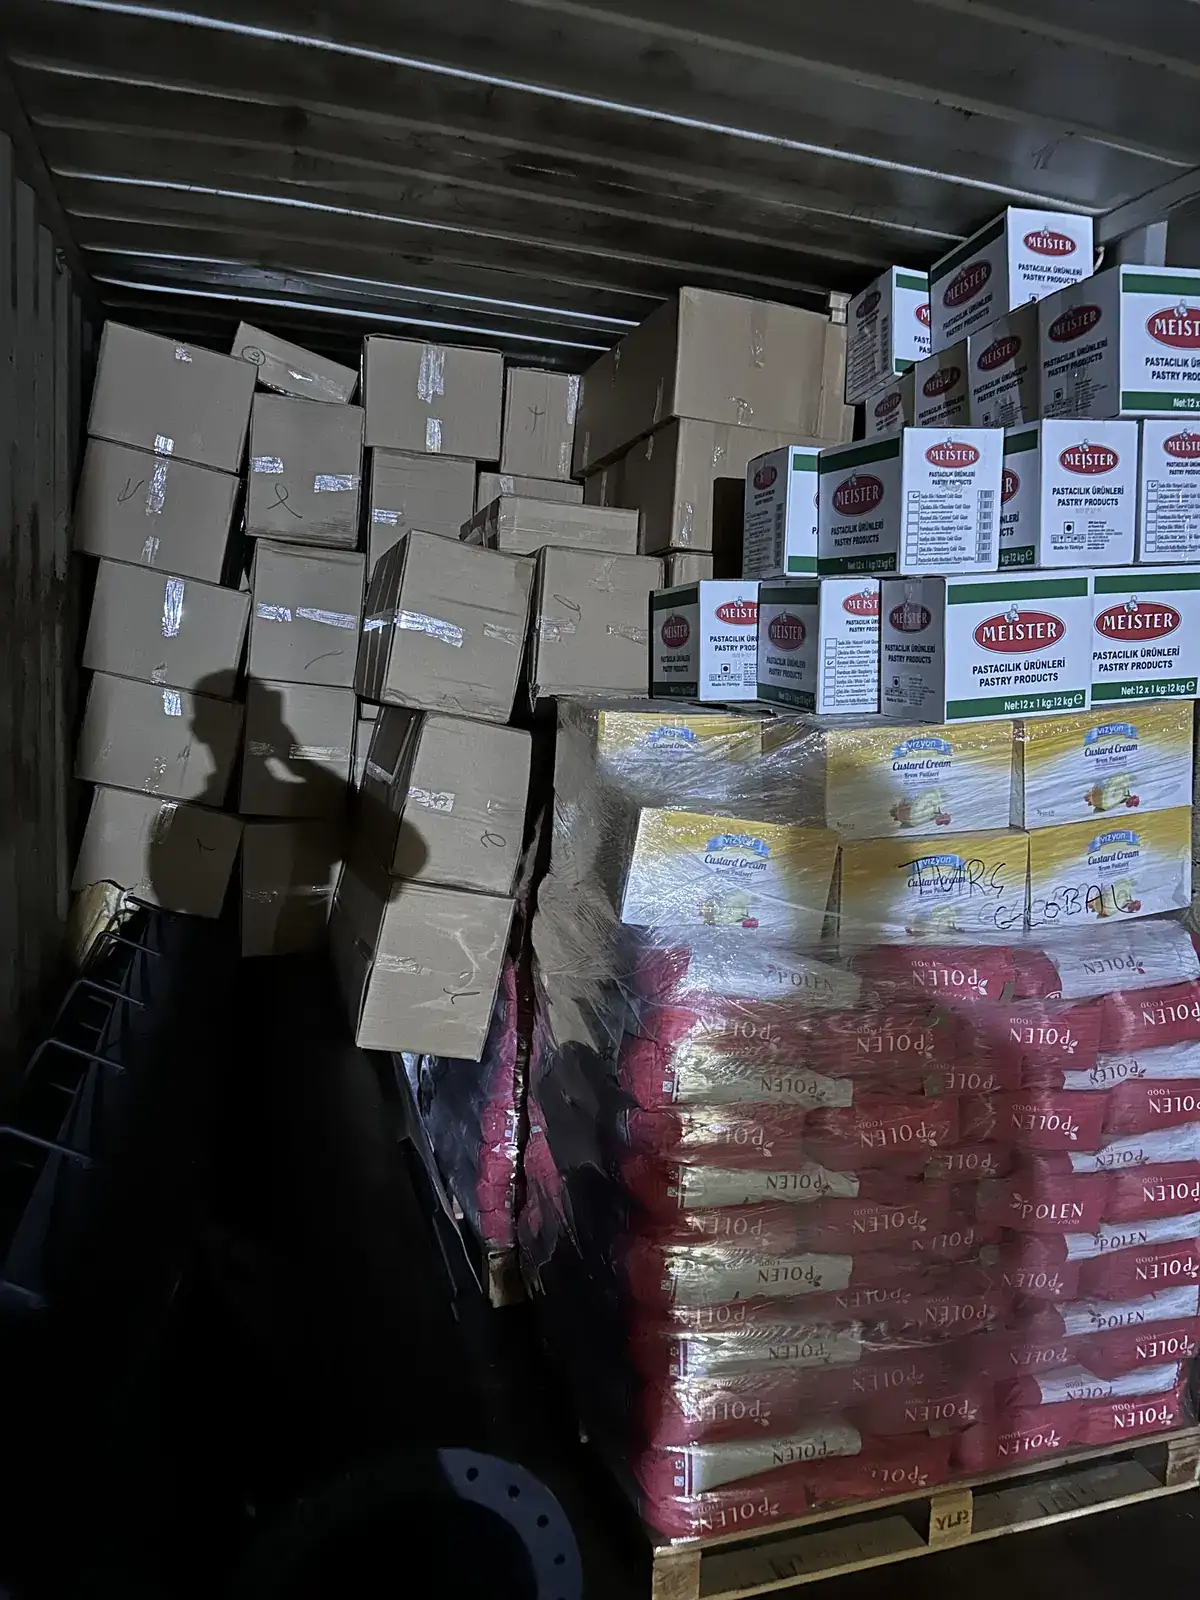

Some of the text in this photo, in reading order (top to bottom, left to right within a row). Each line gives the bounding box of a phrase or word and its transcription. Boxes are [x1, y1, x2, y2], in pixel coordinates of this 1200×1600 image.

[1028, 236, 1072, 251] MEISTER
[1018, 263, 1052, 273] PASTACILIK
[947, 266, 988, 299] MEISTER
[1023, 273, 1046, 282] PASTRY
[1053, 310, 1097, 336] MEISTER
[982, 341, 1018, 365] MEISTE
[1145, 357, 1189, 368] PASTACILIK
[1152, 371, 1180, 381] PASTRY
[930, 450, 975, 460] MEISTER
[1065, 454, 1114, 466] MEISTER
[836, 485, 879, 506] MEISTER
[1052, 486, 1124, 496] PASTACILIK ÜRÜNLERİ
[1058, 498, 1119, 506] PASTRY PRODUCTS
[835, 534, 879, 547] PASTRY PRODUCTS
[893, 612, 927, 624] MEISTER
[1102, 613, 1173, 631] MEISTER
[664, 625, 687, 638] MEISTER
[771, 624, 803, 640] MEISTER
[982, 622, 1057, 643] MEISTER
[1092, 645, 1180, 660] PASTACILIK ÜRÜNLERİ
[973, 657, 1065, 675] PASTACILIK ÜRÜNLERİ
[1099, 659, 1173, 672] PASTRY PRODUCTS
[979, 672, 1058, 687] PASTRY PRODUCTS
[1121, 685, 1143, 696] Net:12
[1176, 683, 1186, 694] kg
[1004, 699, 1028, 711] Net:12
[1063, 696, 1073, 708] kg
[1098, 725, 1124, 735] vizyon
[908, 739, 936, 749] vizyon
[1085, 743, 1138, 757] Custard Cream
[892, 759, 952, 771] Custard Cream
[1100, 832, 1125, 842] vizyon
[705, 854, 767, 871] Custard Cream
[922, 856, 950, 866] vizyon
[1088, 851, 1139, 865] Custard Cream
[1084, 955, 1135, 974] POLEN
[778, 970, 834, 992] POLEN
[912, 968, 978, 987] POLEN
[1143, 1002, 1200, 1026] POLEN
[857, 1034, 925, 1053] POLEN
[1009, 1028, 1070, 1046] POLEN
[945, 1073, 994, 1090] POLE
[1090, 1061, 1138, 1085] POLEN
[760, 1076, 817, 1094] POLEN
[1011, 1114, 1071, 1132] POLEN
[860, 1121, 925, 1148] POLEN
[945, 1153, 992, 1170] POLE
[1095, 1149, 1143, 1168] POLEN
[766, 1175, 822, 1190] POLEN
[1143, 1182, 1200, 1202] POLEN
[1022, 1203, 1084, 1219] POLEN
[691, 1212, 762, 1235] POLEN
[852, 1210, 919, 1233] POLEN
[1100, 1232, 1148, 1250] POLEN
[758, 1266, 815, 1283] POLEN
[1135, 1257, 1191, 1280] POLEN
[1003, 1273, 1058, 1288] POLEN
[925, 1304, 987, 1323] POLEN
[1098, 1310, 1146, 1328] POLEN
[769, 1343, 825, 1359] POLEN
[1135, 1335, 1188, 1360] POLEN
[1009, 1348, 1067, 1365] POLEN
[689, 1400, 761, 1423] POLEN
[904, 1399, 969, 1422] POLEN
[1112, 1404, 1135, 1412] FOOD
[1114, 1406, 1167, 1429] POLEN
[998, 1430, 1054, 1456] POLEN
[772, 1442, 828, 1465] POLEN
[699, 1497, 769, 1534] POLEN
